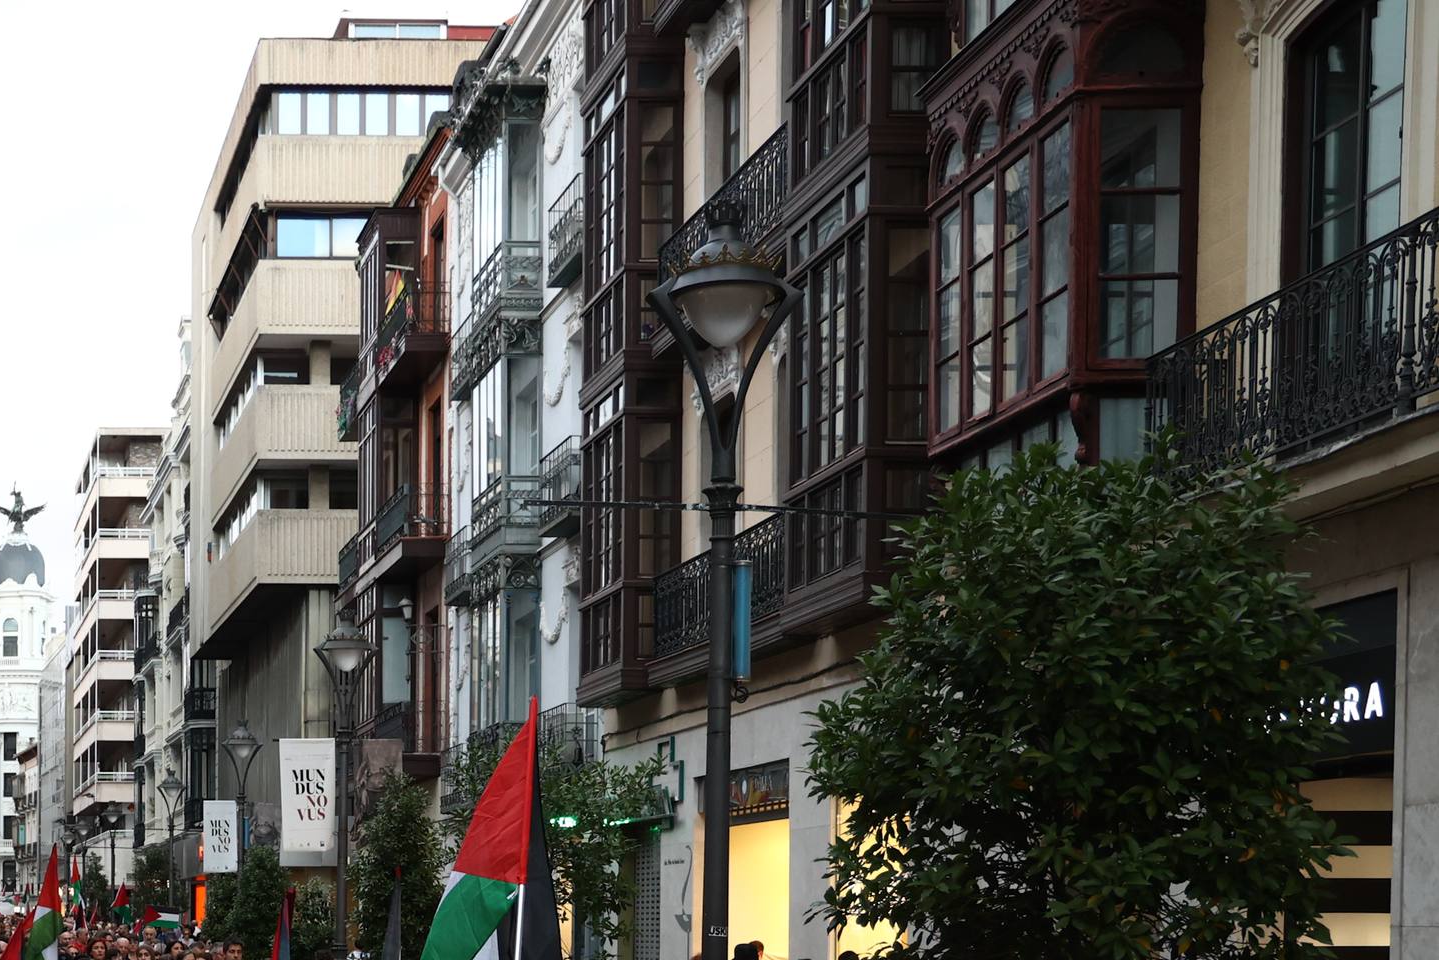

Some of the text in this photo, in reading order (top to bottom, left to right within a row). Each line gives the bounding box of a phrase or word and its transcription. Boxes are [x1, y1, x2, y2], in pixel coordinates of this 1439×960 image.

[292, 769, 326, 782] MUN
[295, 782, 325, 795] DUS
[307, 795, 328, 807] NO
[297, 808, 326, 821] VUS
[210, 820, 230, 828] MUN
[211, 828, 229, 836] DUS
